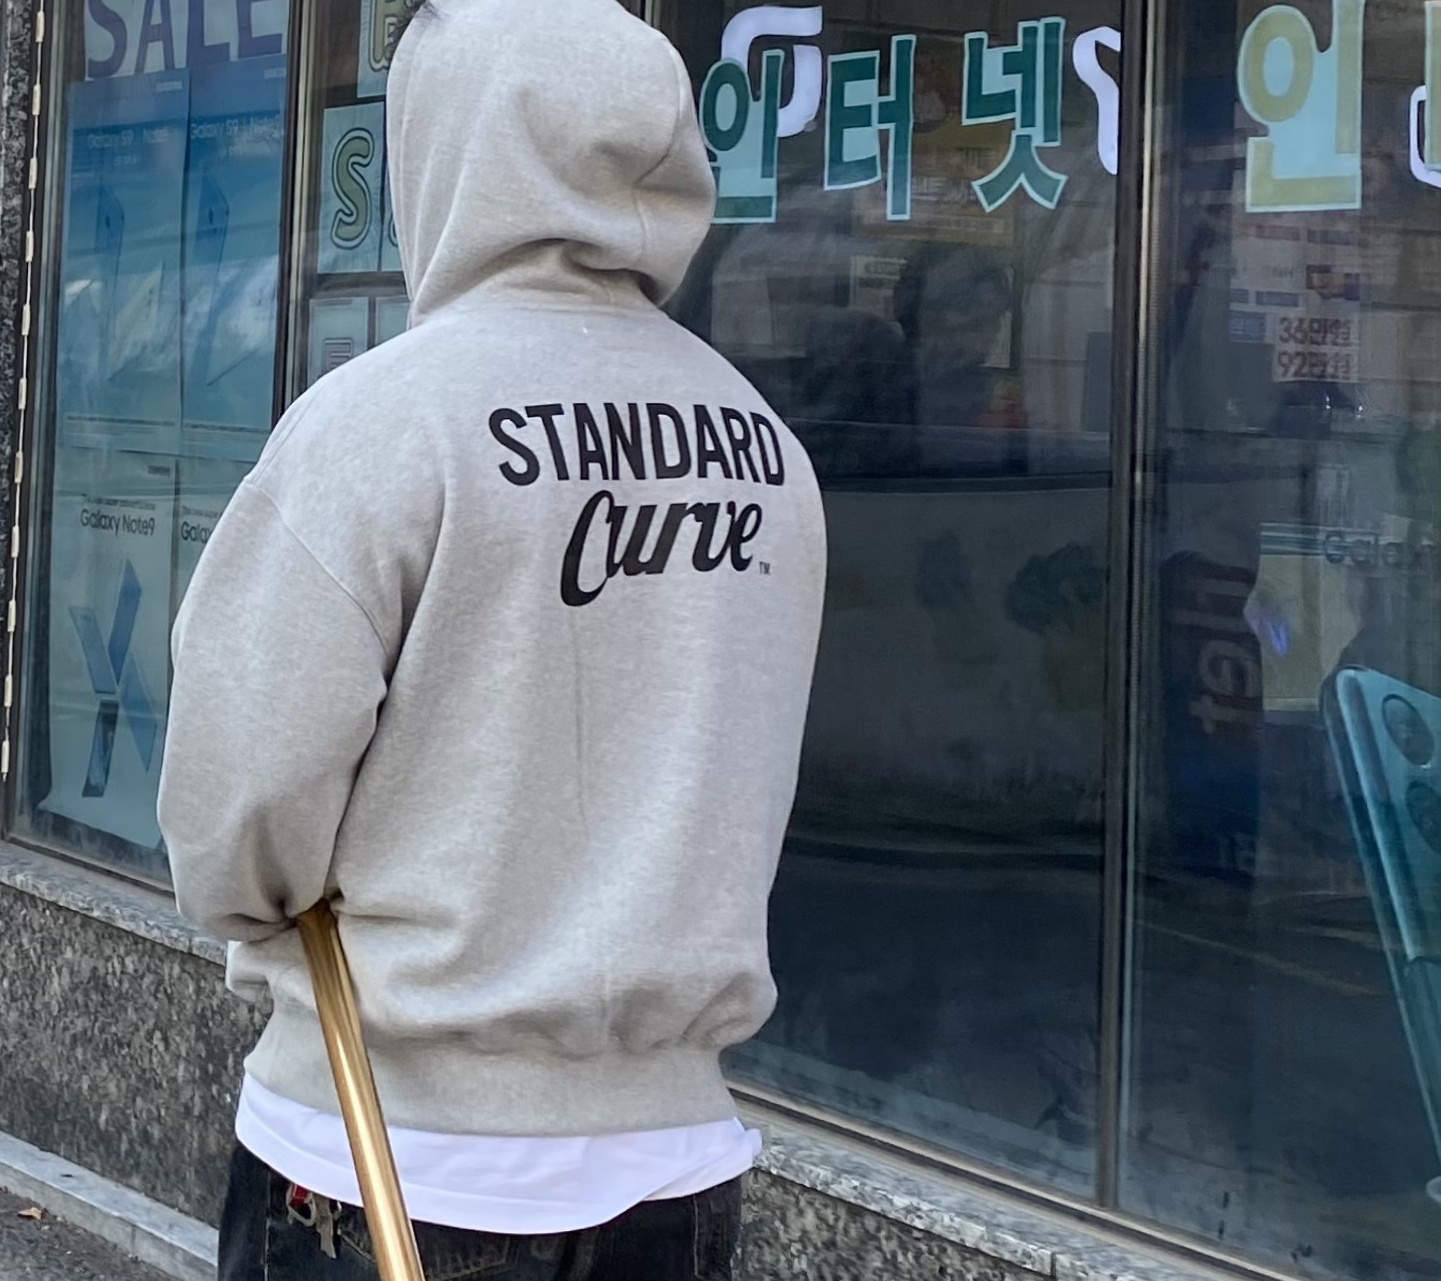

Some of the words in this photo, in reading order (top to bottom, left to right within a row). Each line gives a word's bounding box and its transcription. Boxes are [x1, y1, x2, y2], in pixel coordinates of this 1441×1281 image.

[700, 16, 1068, 224] 인터넷
[488, 403, 785, 486] STANDARD
[80, 508, 120, 535] Galaxy
[122, 513, 156, 536] Note9
[560, 490, 763, 607] Curve
